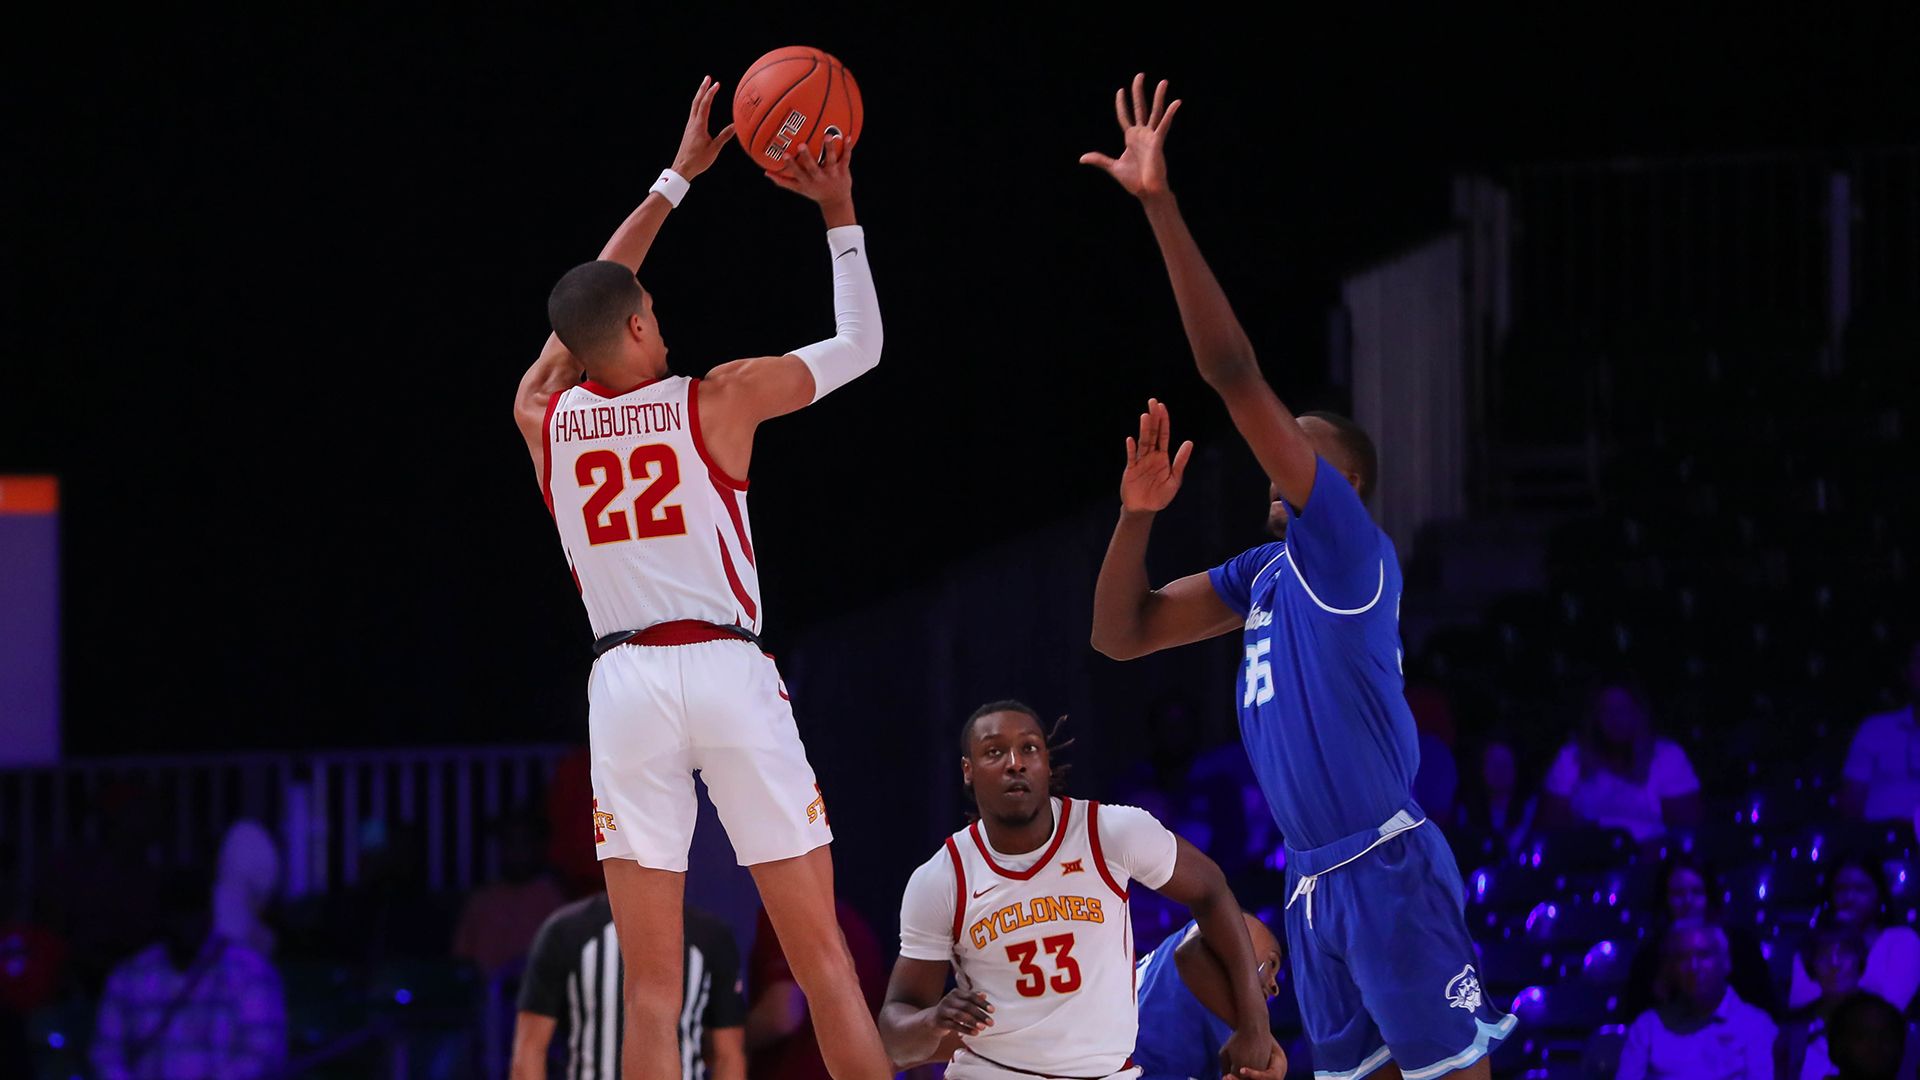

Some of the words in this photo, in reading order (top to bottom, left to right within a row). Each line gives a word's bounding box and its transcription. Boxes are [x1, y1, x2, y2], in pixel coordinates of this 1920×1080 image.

[555, 402, 681, 443] HALIBURTON
[575, 443, 688, 546] 22
[969, 895, 1105, 950] CYCLONES
[1004, 932, 1082, 998] 33
